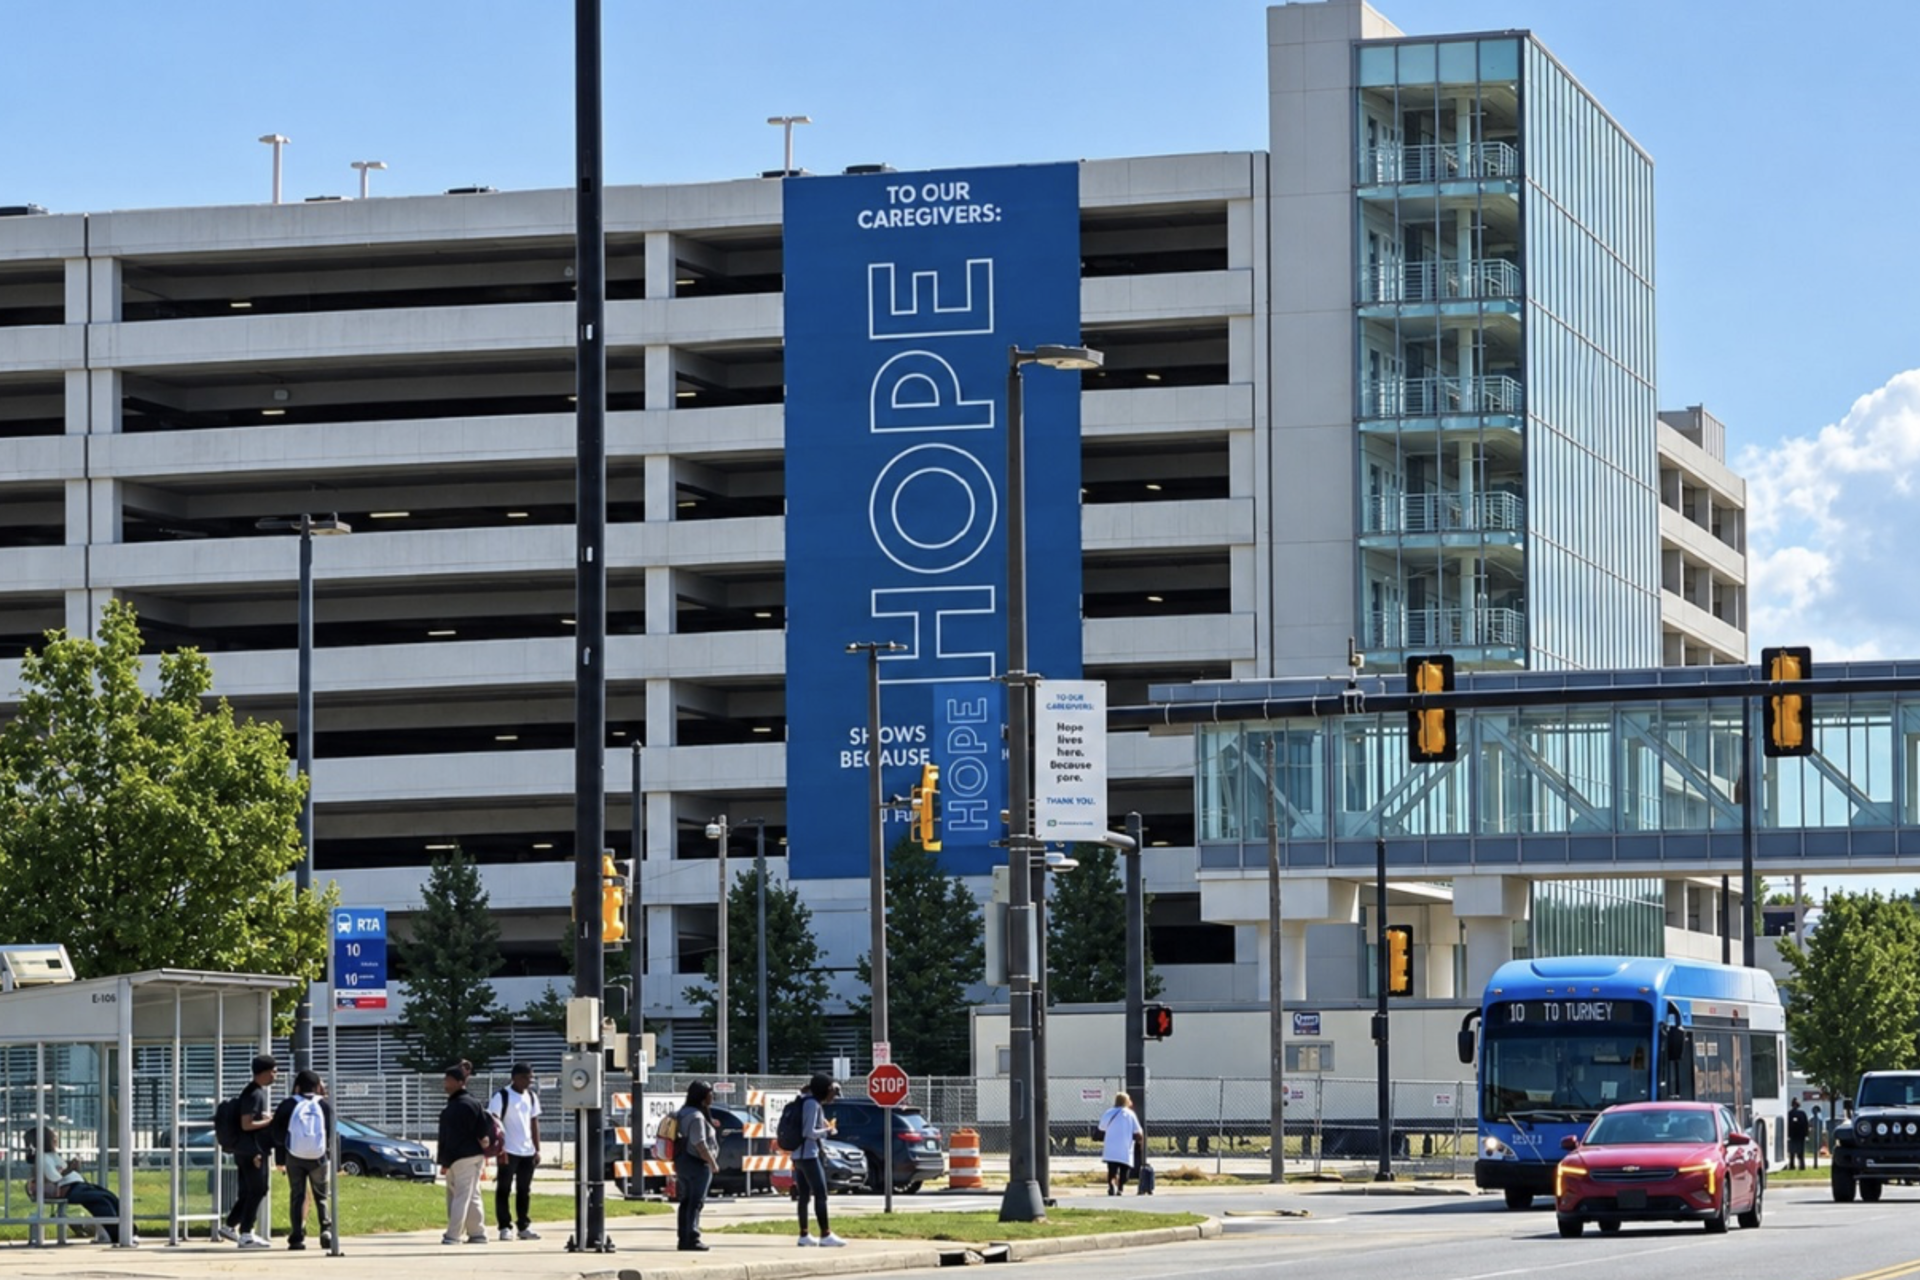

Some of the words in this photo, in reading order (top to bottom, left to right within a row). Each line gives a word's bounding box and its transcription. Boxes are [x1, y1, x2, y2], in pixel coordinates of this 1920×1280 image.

[887, 185, 916, 204] TO
[922, 182, 970, 202] OUR
[857, 203, 1002, 229] CAREGIVERS:
[868, 258, 998, 685] HOPE
[1057, 722, 1084, 734] Hope
[1057, 735, 1083, 744] lives
[947, 697, 989, 831] HOPE
[1050, 760, 1092, 770] Because
[357, 918, 381, 932] RTA
[346, 943, 361, 957] 10
[345, 973, 358, 986] 10
[1510, 1003, 1525, 1022] 10
[1543, 1002, 1559, 1022] TO
[1565, 1002, 1613, 1021] TURNEY
[871, 1077, 905, 1093] STOP
